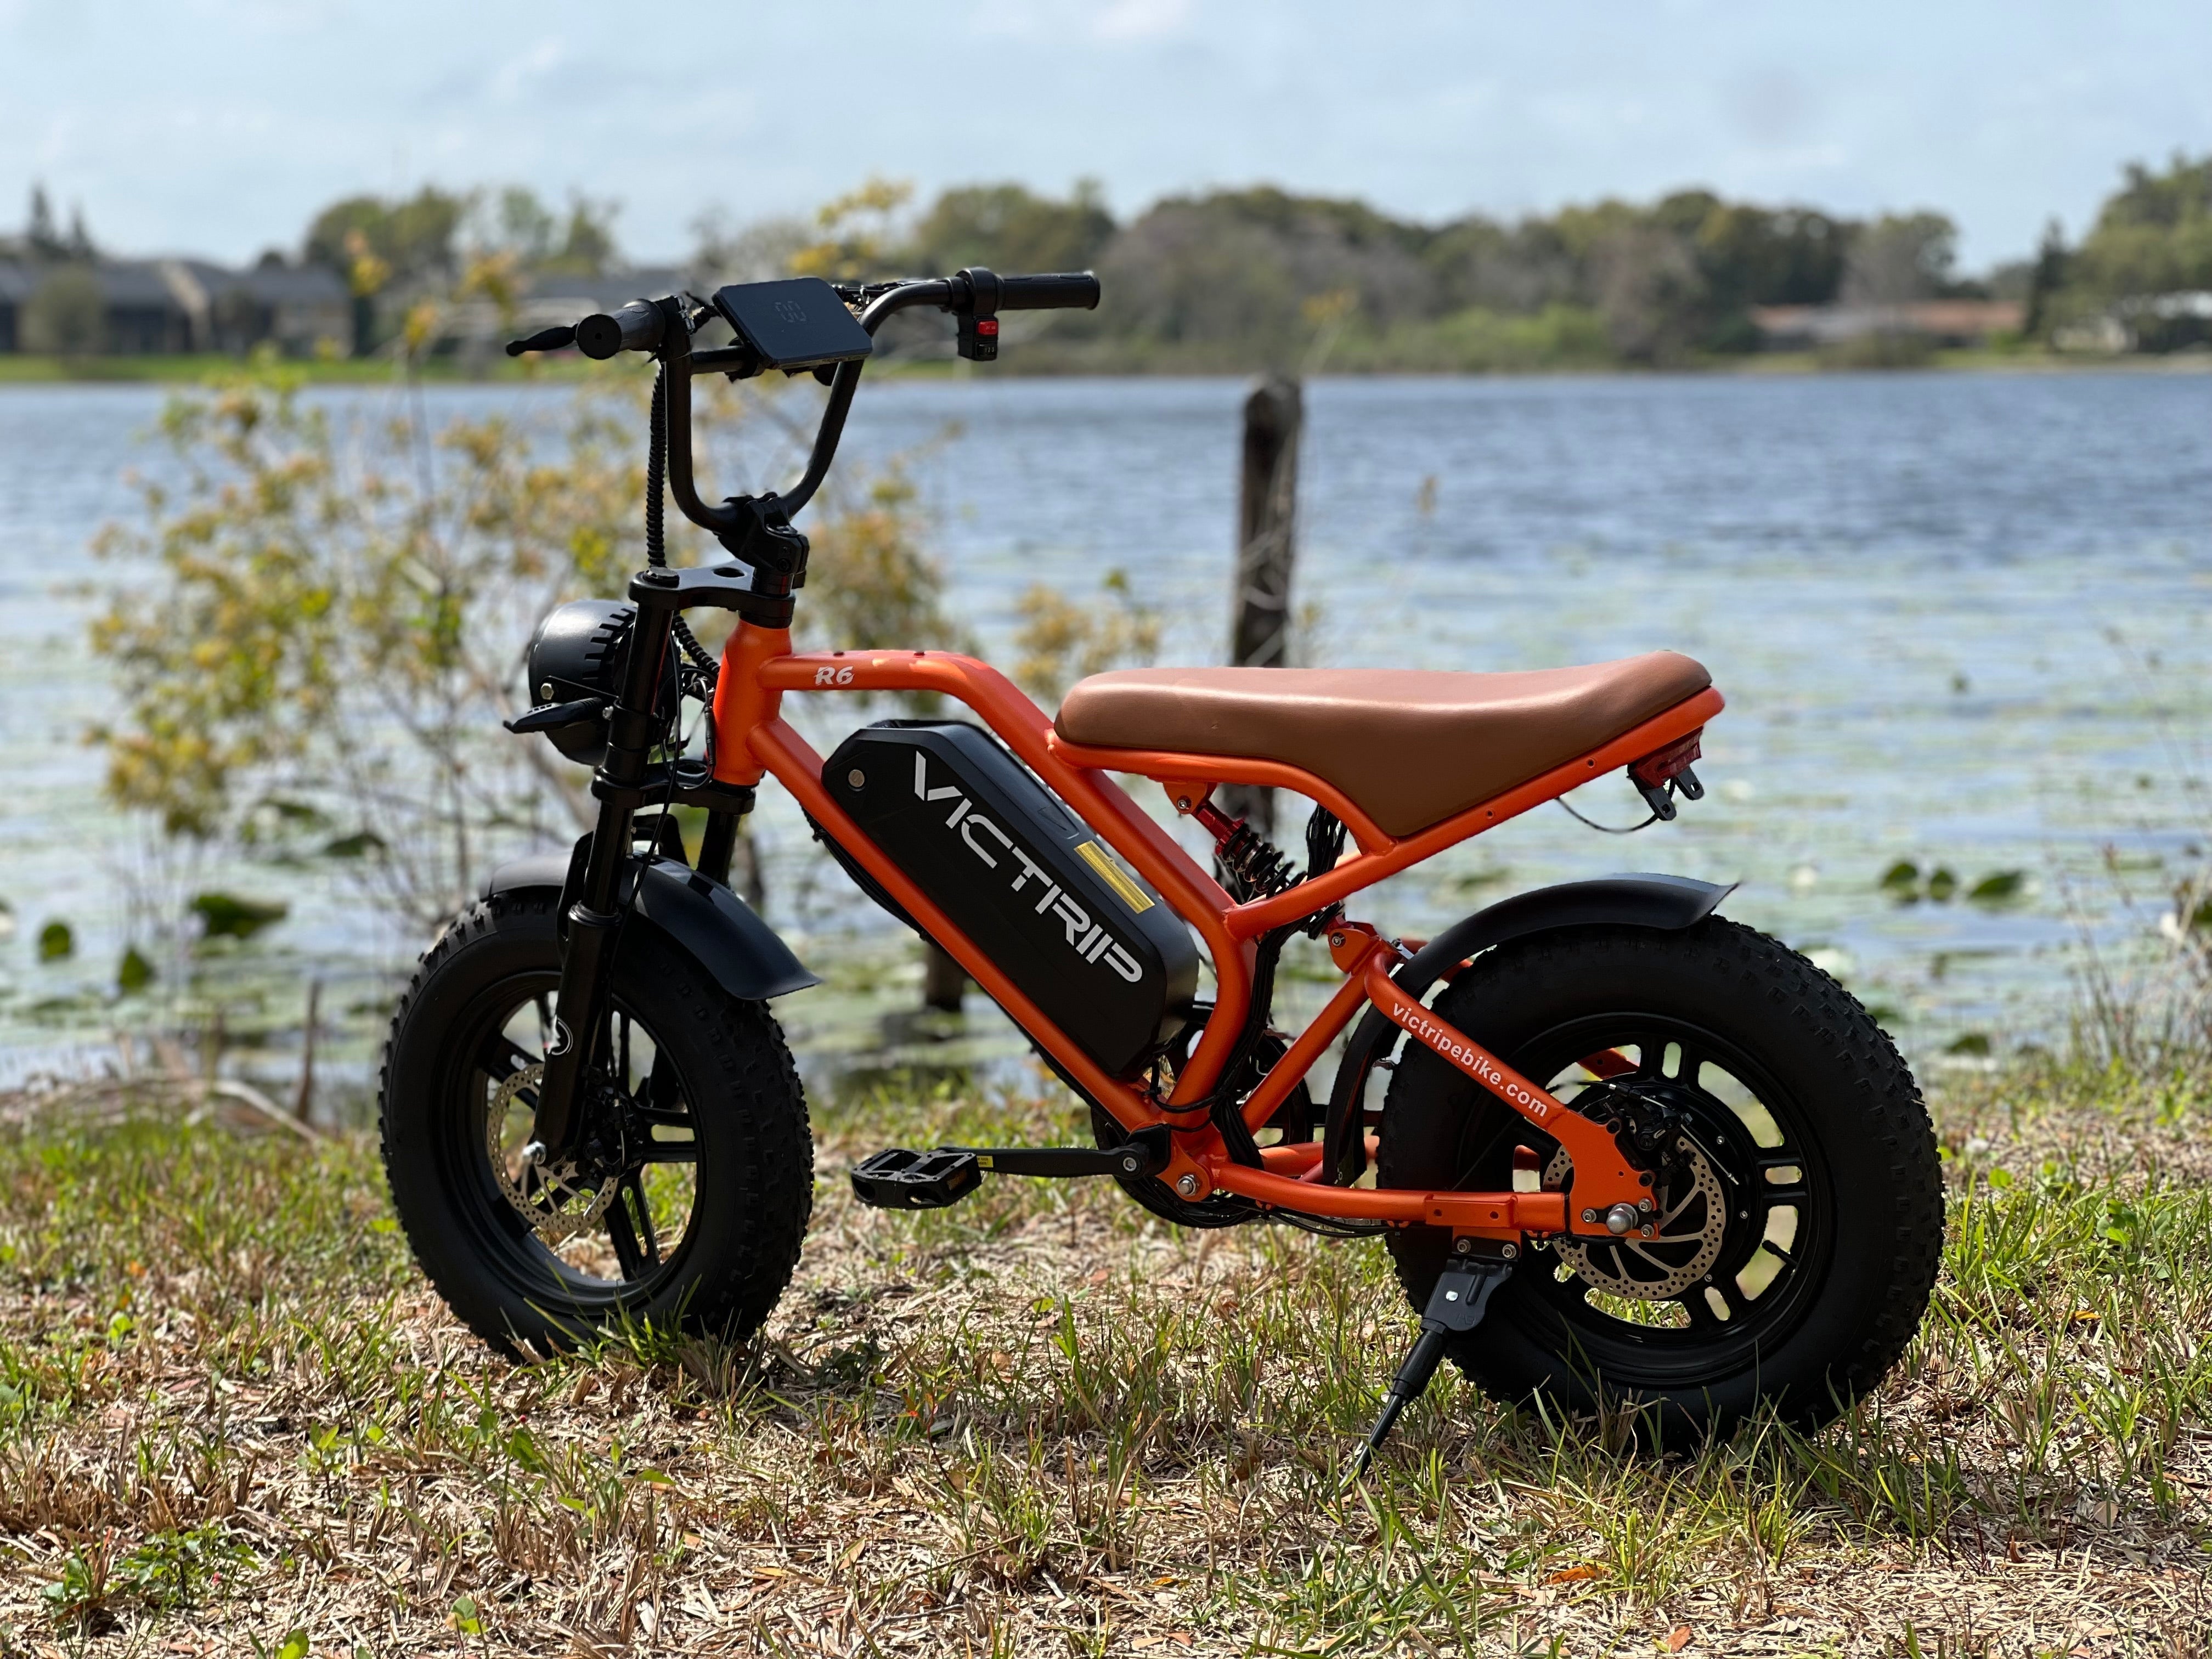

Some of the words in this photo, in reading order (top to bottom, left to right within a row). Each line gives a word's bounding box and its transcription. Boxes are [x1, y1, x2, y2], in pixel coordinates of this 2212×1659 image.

[814, 666, 854, 686] R6
[915, 751, 1143, 983] VICTRIP
[1393, 1003, 1548, 1117] victripebike.com
